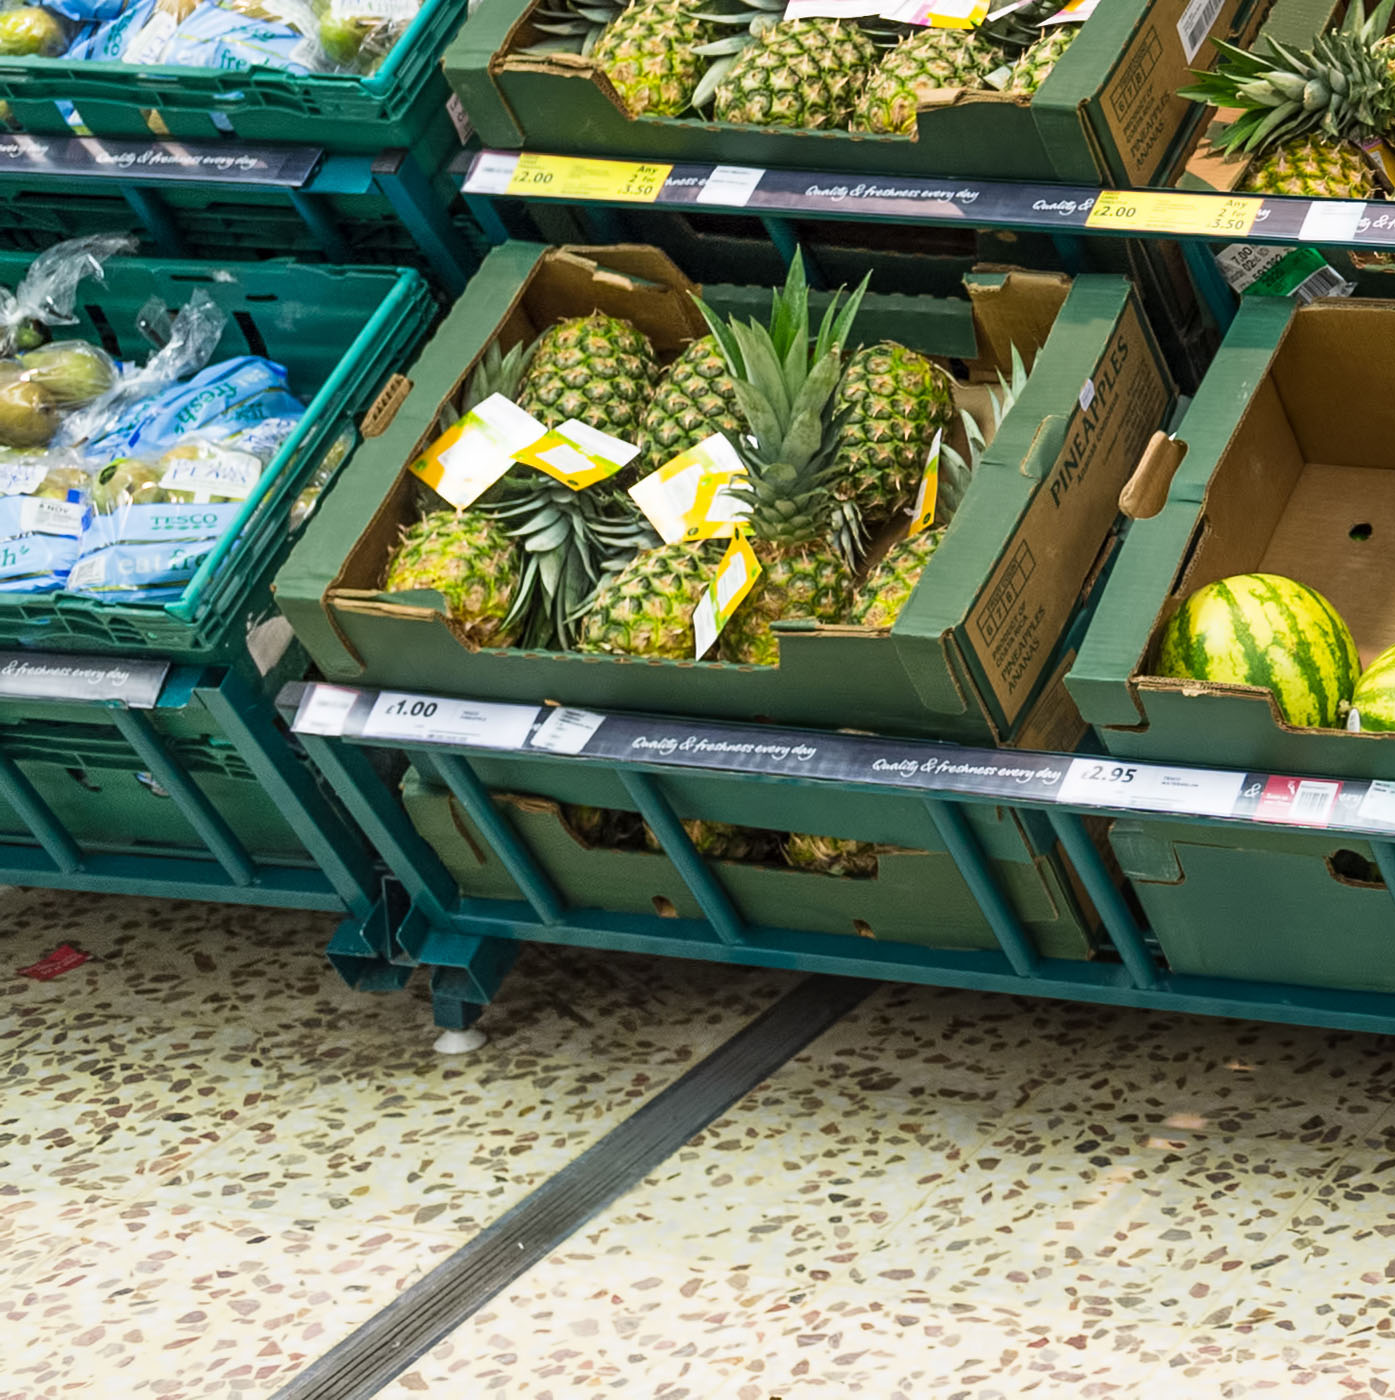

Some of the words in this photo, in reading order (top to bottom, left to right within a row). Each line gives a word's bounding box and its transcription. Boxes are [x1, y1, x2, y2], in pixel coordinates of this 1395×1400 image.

[1129, 88, 1172, 158] PINEAPPLES
[1135, 120, 1165, 171] ANANAS
[638, 165, 658, 174] Any
[513, 171, 554, 184] £2.00
[630, 174, 637, 182] 2
[617, 184, 654, 195] £3.50
[1094, 205, 1137, 219] £2.00
[1226, 200, 1247, 209] Any
[1206, 218, 1245, 231] £3.50
[1372, 215, 1389, 230] &
[175, 381, 238, 425] fresh
[1048, 334, 1130, 509] PINEAPPLES
[151, 512, 218, 525] TESCO
[999, 604, 1047, 683] PINEAPPLES
[1005, 638, 1042, 696] ANANAS
[385, 699, 438, 718] £1.00
[872, 757, 919, 777] Quality
[920, 757, 938, 773] &
[934, 760, 998, 776] freshness
[998, 765, 1035, 783] every
[1036, 765, 1062, 785] day
[1081, 766, 1137, 783] £2.95
[1244, 783, 1262, 798] &
